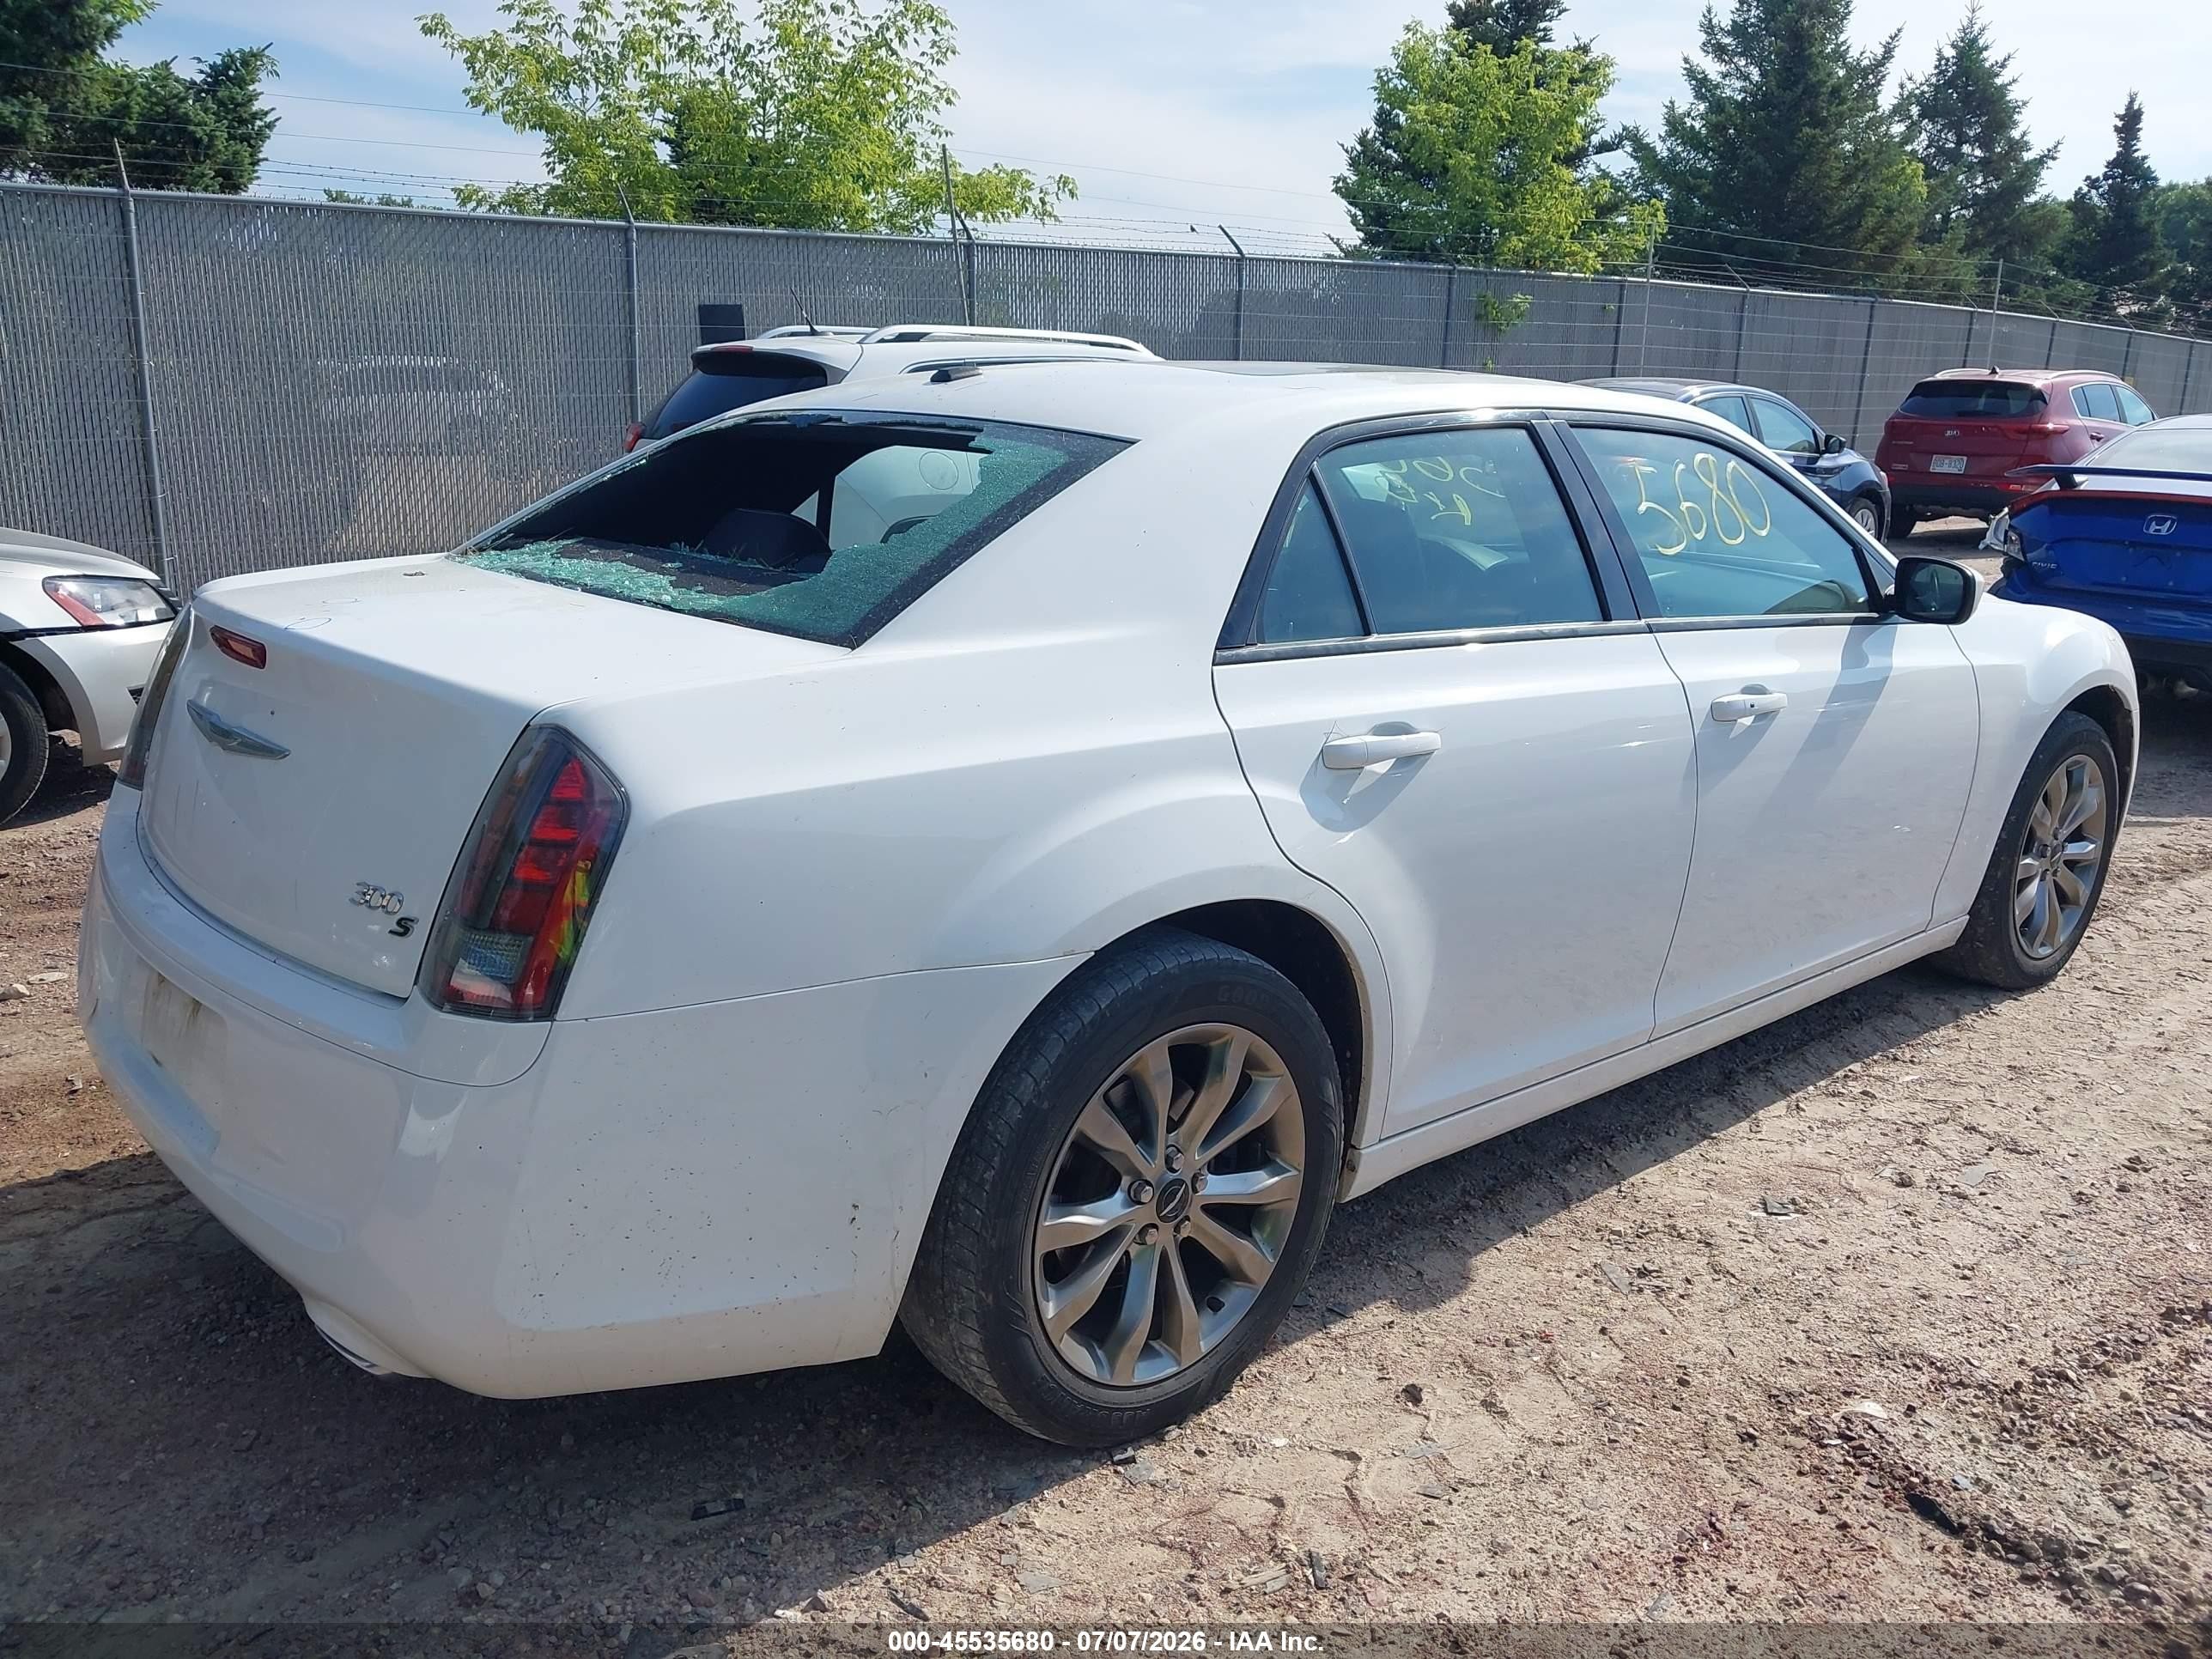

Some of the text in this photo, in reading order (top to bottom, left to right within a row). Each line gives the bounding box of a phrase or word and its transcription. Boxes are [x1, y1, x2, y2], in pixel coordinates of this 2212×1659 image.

[1631, 452, 1772, 556] 5680
[349, 879, 404, 916] 300
[387, 915, 420, 939] S
